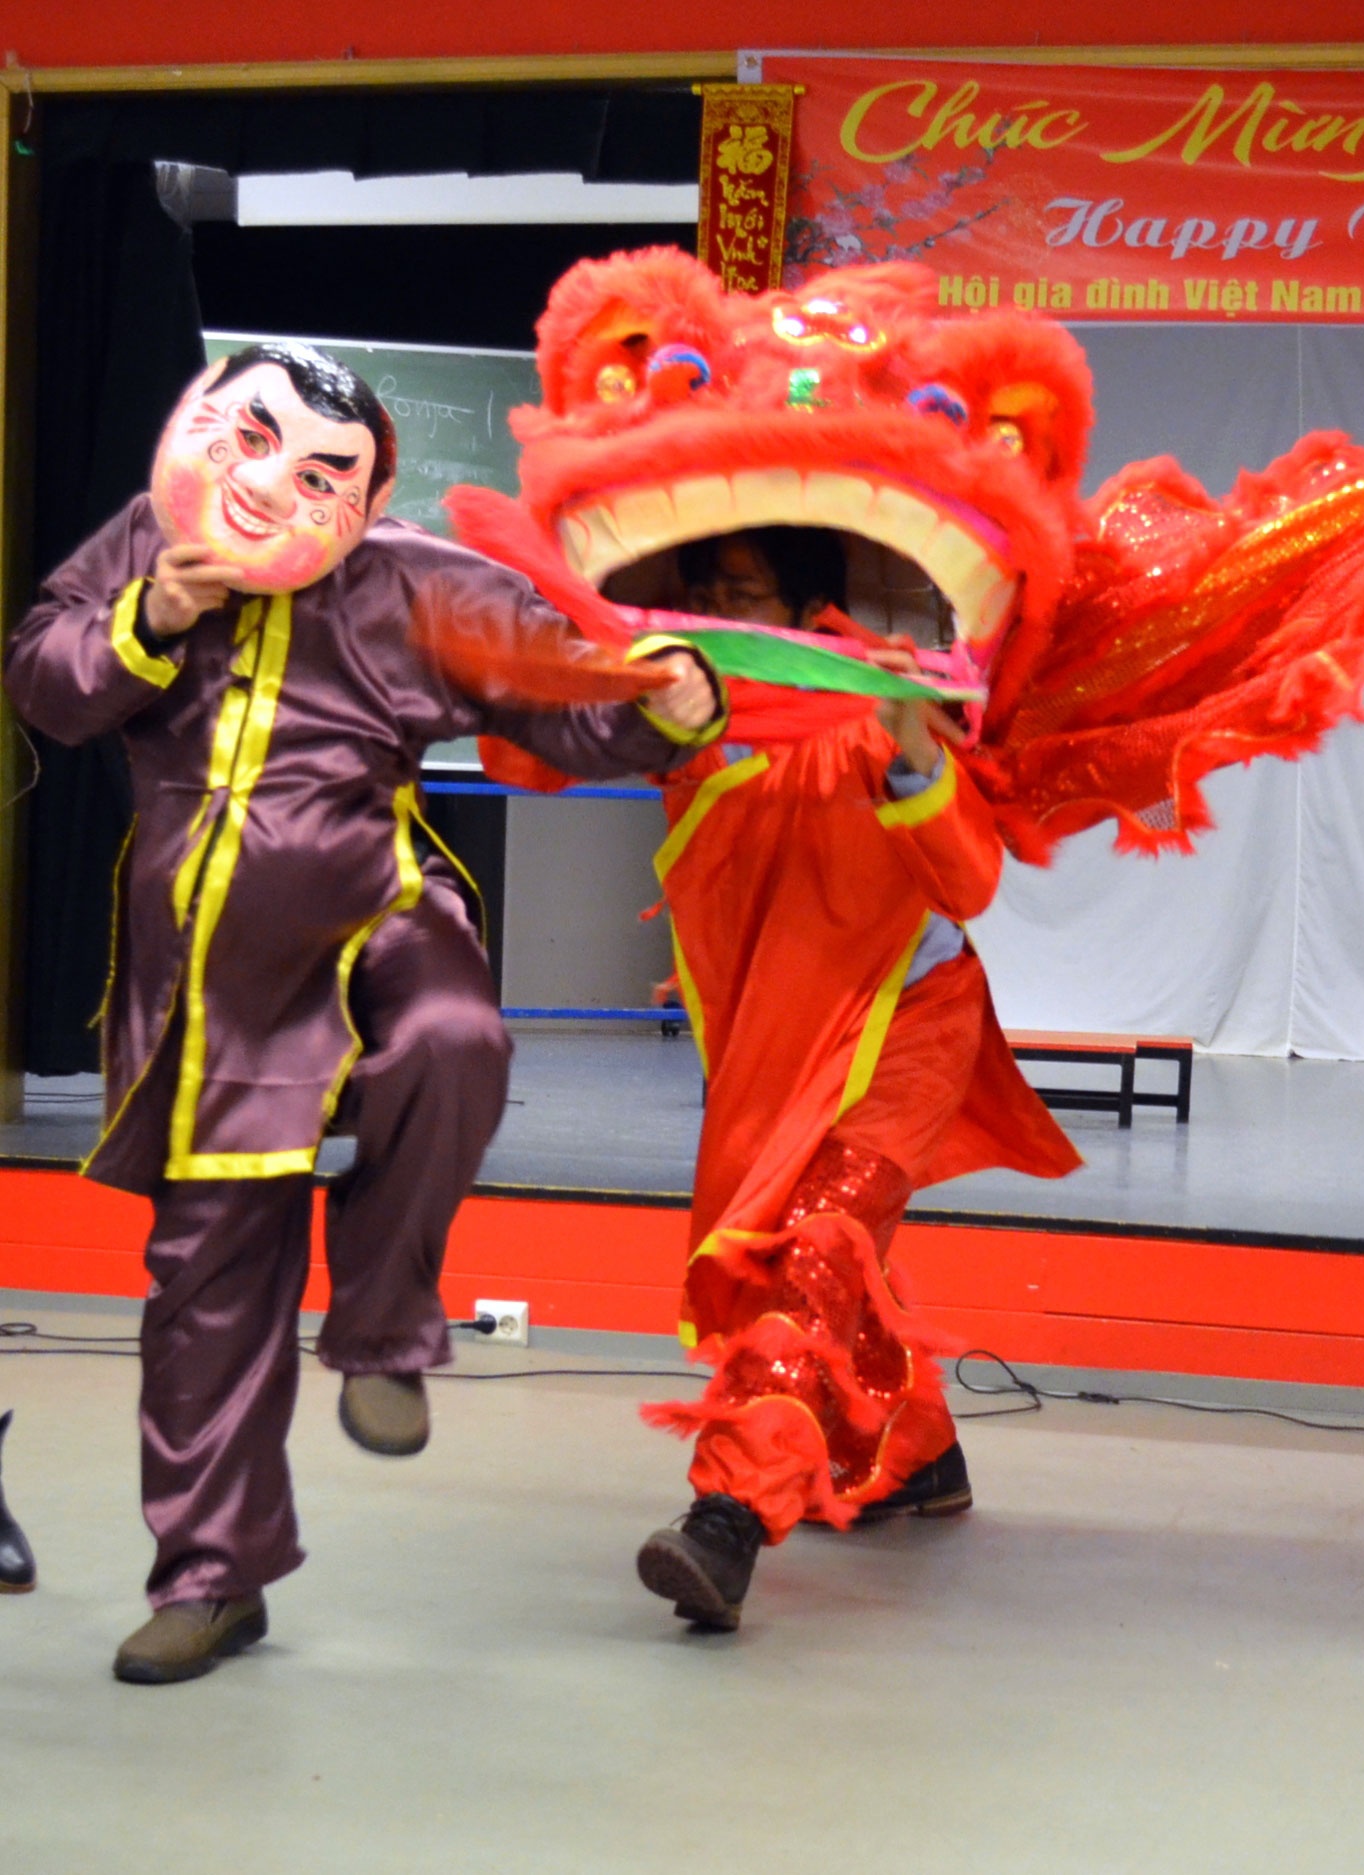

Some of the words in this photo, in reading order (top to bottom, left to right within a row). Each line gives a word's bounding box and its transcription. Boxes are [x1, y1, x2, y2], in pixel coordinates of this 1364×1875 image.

[716, 124, 773, 175] 福
[839, 78, 1090, 164] Chúc
[1042, 197, 1324, 261] Happy
[937, 275, 1000, 314] Hội
[1013, 278, 1073, 310] gia
[1086, 276, 1168, 311] đình
[1182, 279, 1259, 318] Việt
[1271, 281, 1362, 314] Nam
